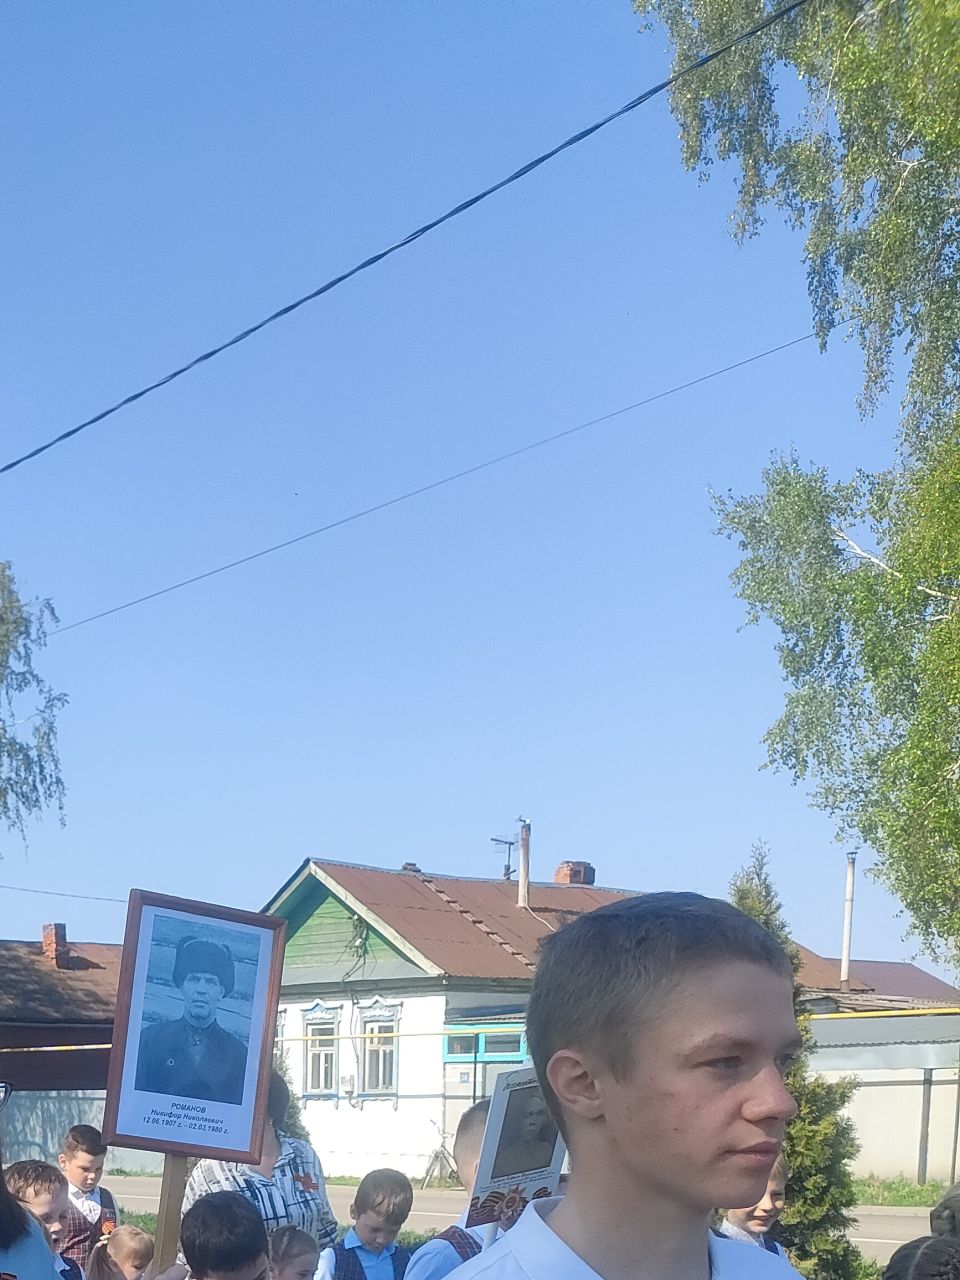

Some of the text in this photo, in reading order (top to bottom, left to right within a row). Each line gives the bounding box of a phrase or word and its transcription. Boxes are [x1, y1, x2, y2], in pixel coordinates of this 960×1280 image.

[170, 1102, 207, 1114] РОМАНОВ
[150, 1108, 224, 1125] Никифор Николаевич
